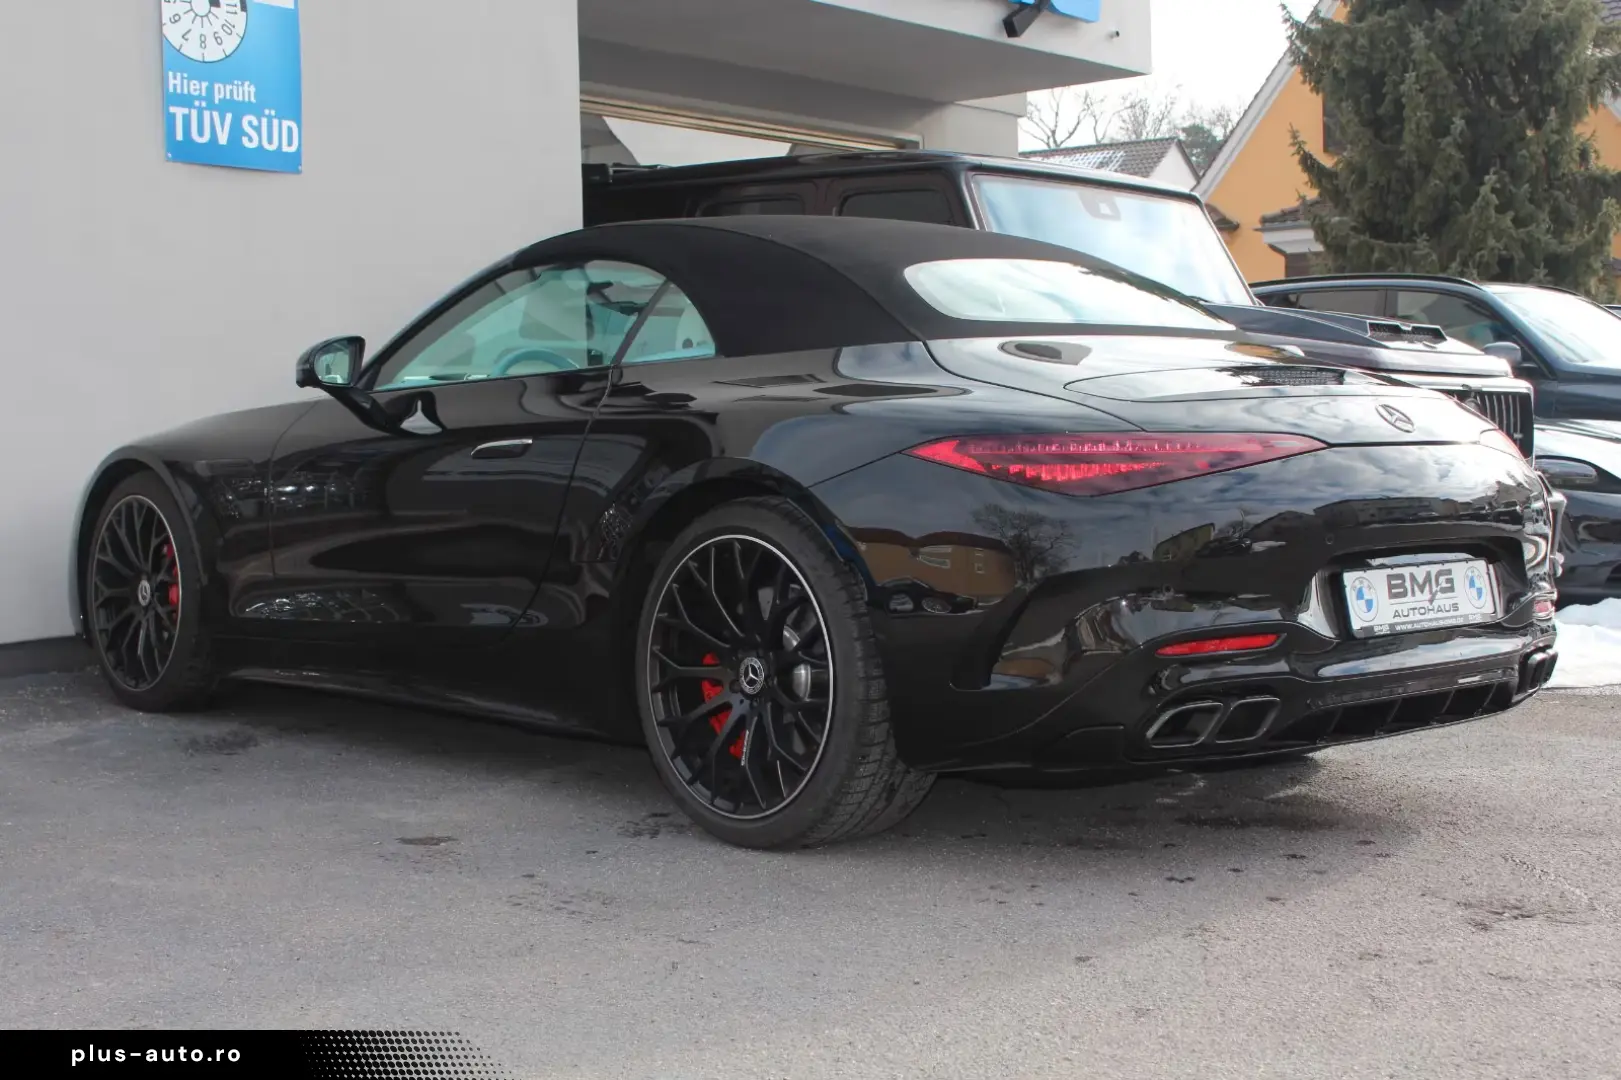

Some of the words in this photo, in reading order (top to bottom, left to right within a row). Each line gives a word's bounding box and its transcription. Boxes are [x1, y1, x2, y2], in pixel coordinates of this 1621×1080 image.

[225, 3, 238, 15] 11
[221, 19, 235, 35] 10
[199, 33, 207, 50] 8
[168, 71, 209, 97] Hier
[213, 80, 256, 104] prüft
[169, 100, 232, 146] TÜV
[241, 109, 299, 153] SÜD
[1386, 568, 1455, 604] BMG
[1392, 602, 1460, 619] AUTOHAUS
